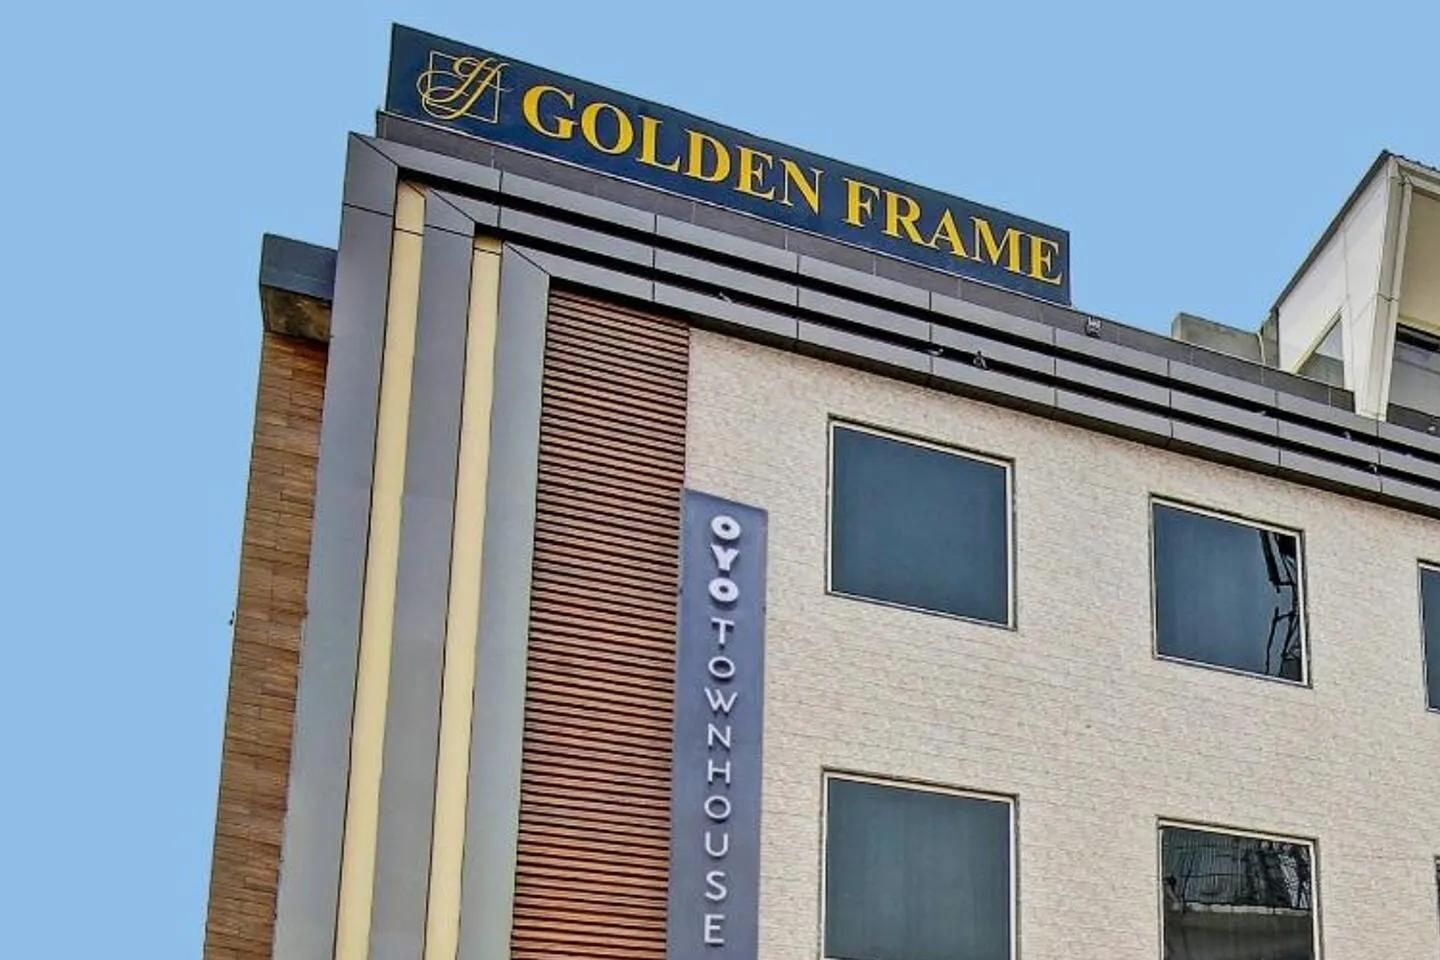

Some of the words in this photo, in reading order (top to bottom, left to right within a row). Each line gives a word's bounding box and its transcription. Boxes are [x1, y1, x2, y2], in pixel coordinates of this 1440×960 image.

[521, 83, 825, 216] GOLDEN
[842, 176, 1063, 286] FRAME
[708, 515, 741, 602] OYO
[704, 617, 738, 944] TOWNHOUSE
